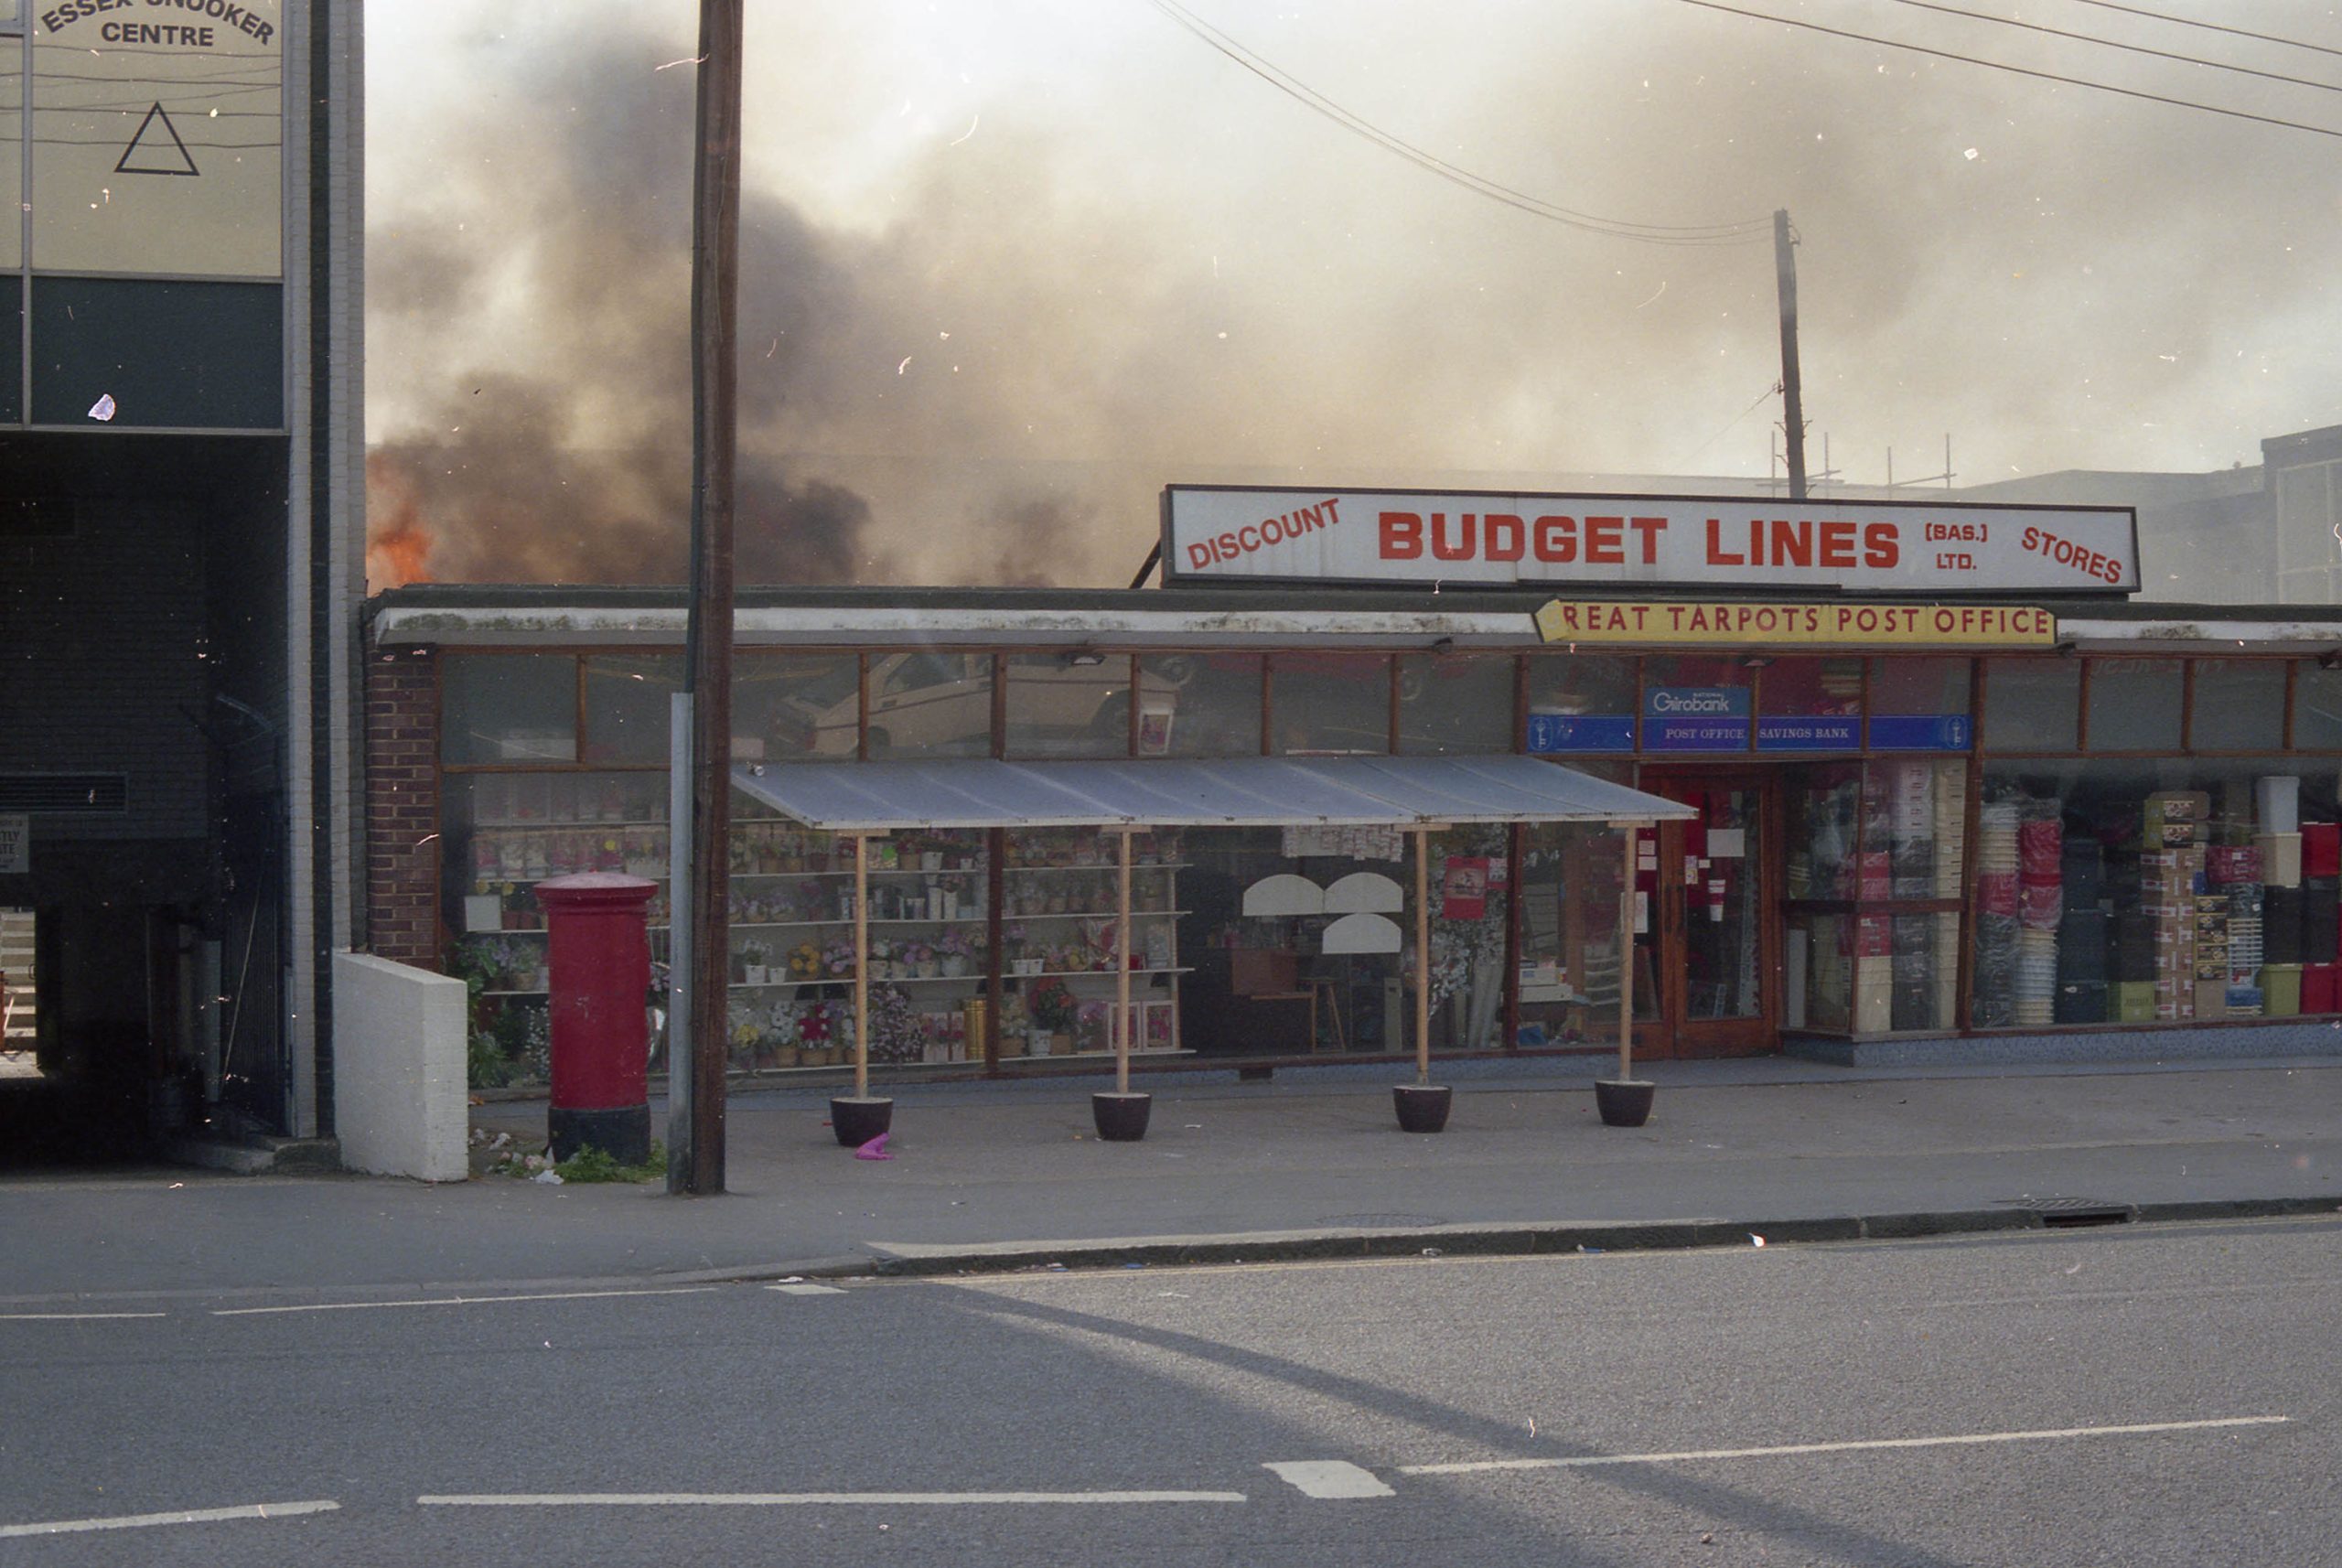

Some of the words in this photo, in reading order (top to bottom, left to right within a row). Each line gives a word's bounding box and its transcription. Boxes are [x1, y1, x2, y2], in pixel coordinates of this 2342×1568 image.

[102, 22, 213, 47] CENTRE
[146, 0, 274, 46] OOKER
[1187, 499, 1339, 570] DISCOUNT
[1379, 512, 1669, 564] BUDGET
[1706, 519, 1899, 569] LINES
[1937, 553, 1977, 570] LTD.
[2022, 527, 2122, 584] STORES
[1668, 606, 1819, 632] TARPOTS
[1838, 608, 1919, 633] POST
[1935, 609, 2048, 634] OFFICE
[1653, 692, 1729, 712] Girobank
[1666, 728, 1697, 739] POST
[1700, 728, 1745, 739] OFFICE
[1759, 728, 1811, 739] SAVINGS
[1816, 728, 1849, 739] BANK
[0, 831, 20, 842] TLY
